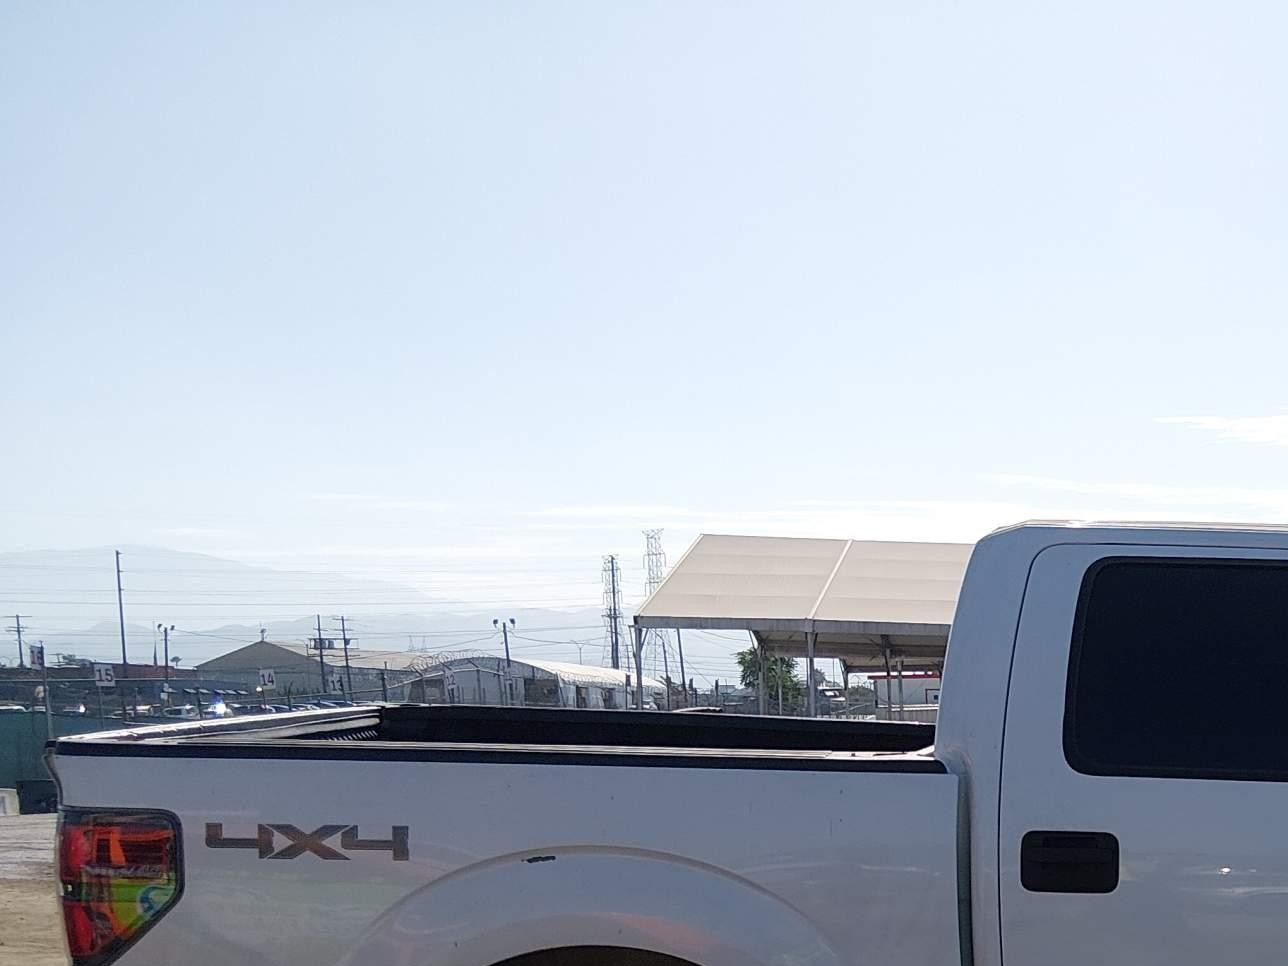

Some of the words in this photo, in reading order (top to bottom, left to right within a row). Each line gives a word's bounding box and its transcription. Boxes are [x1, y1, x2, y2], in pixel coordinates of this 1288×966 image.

[96, 669, 113, 682] 15
[261, 673, 274, 686] 14
[205, 823, 409, 861] 4X4
